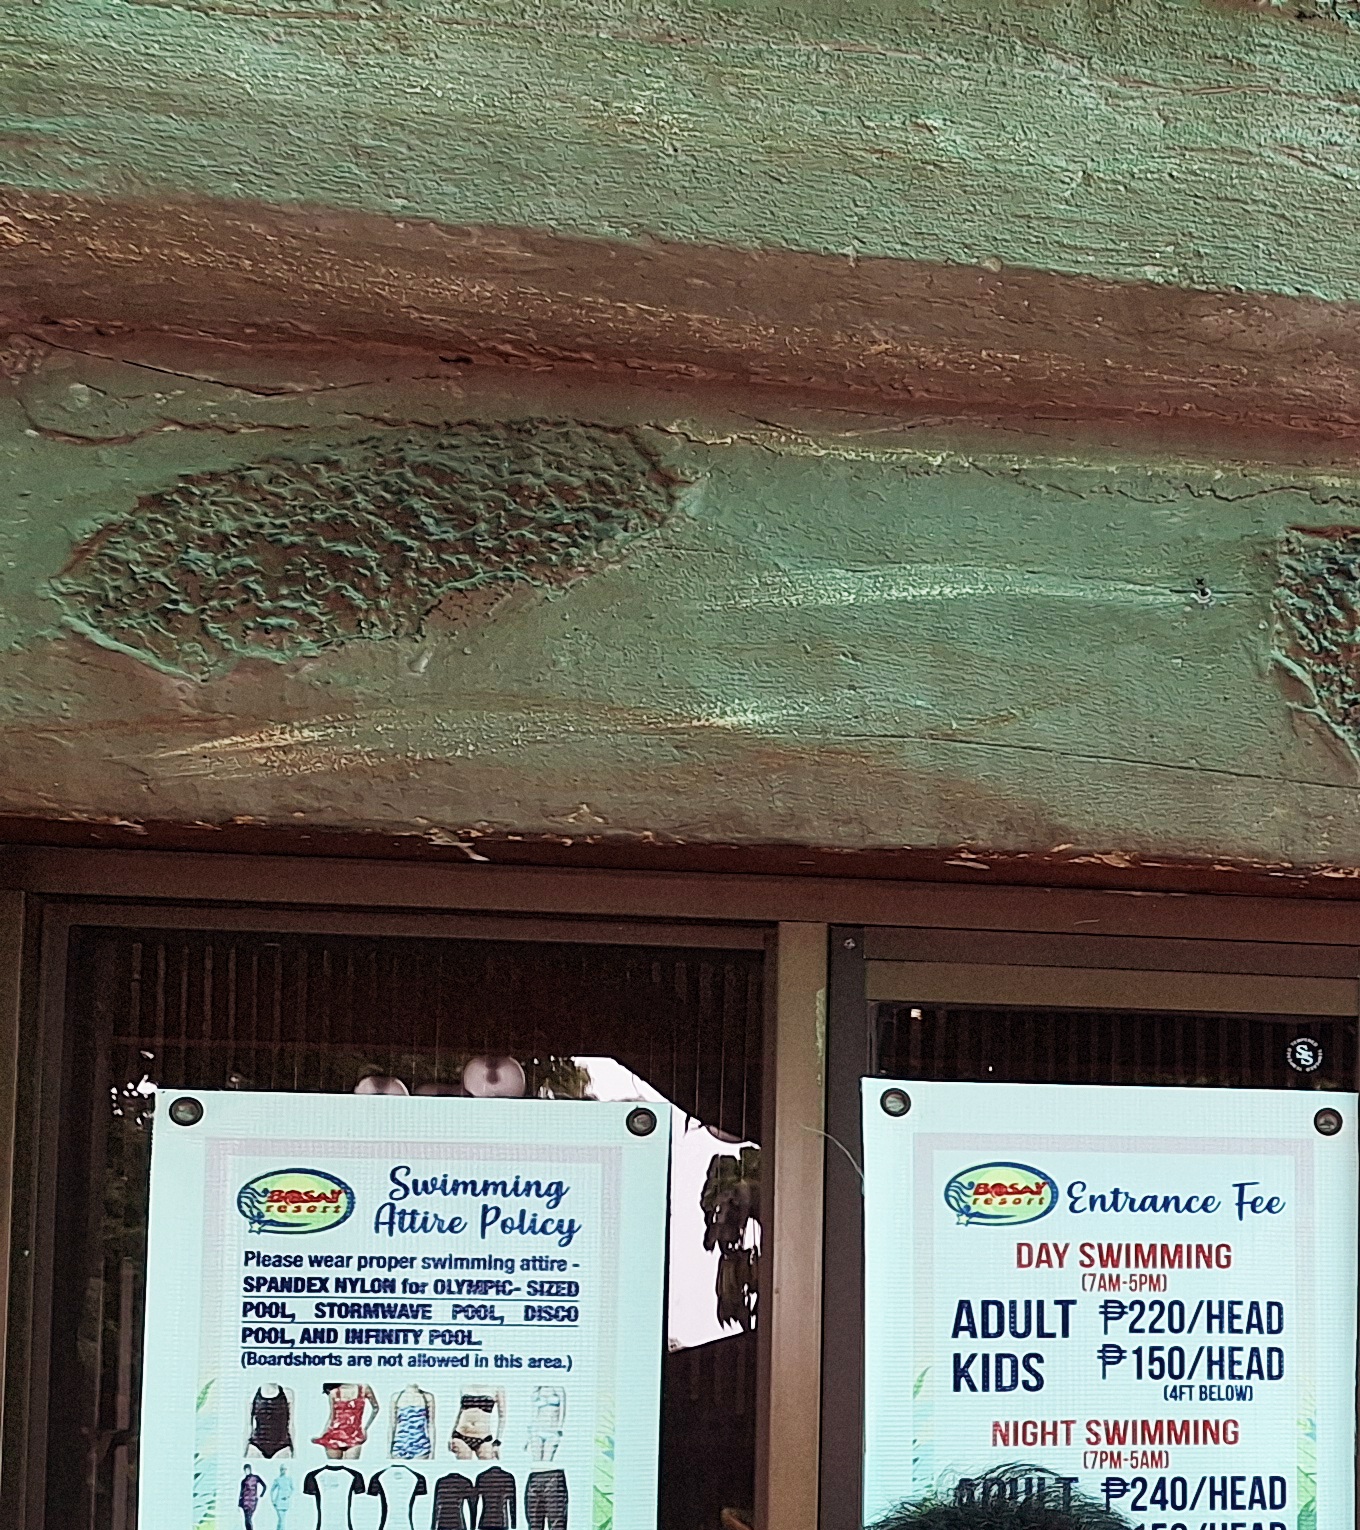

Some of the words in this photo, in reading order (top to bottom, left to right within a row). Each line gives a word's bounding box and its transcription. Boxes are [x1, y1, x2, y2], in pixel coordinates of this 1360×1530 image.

[388, 1166, 569, 1206] Swimming
[973, 1182, 1047, 1197] BOSAY
[265, 1204, 342, 1215] resort
[972, 1197, 1045, 1206] resort
[1067, 1181, 1221, 1213] Entrance
[1232, 1182, 1285, 1221] Fee
[373, 1203, 467, 1237] Attire
[479, 1205, 582, 1247] Policy
[244, 1251, 303, 1267] Please
[308, 1255, 353, 1268] wear
[357, 1256, 417, 1272] proper
[422, 1254, 515, 1274] swimming
[520, 1256, 567, 1272] attire
[1017, 1243, 1069, 1268] DAY
[1079, 1242, 1231, 1269] SWIMMING
[243, 1278, 328, 1294] SPANDEX
[334, 1279, 396, 1294] NYLON
[400, 1280, 426, 1294] for
[526, 1281, 580, 1298] SIZED
[1082, 1273, 1167, 1292] (7AM-5PM)
[242, 1302, 295, 1321] POOL,
[315, 1303, 432, 1320] STORMWAVE
[452, 1304, 504, 1324] POOL,
[524, 1305, 578, 1322] DISCO
[951, 1300, 1077, 1338] ADULT
[242, 1328, 295, 1347] POOL,
[300, 1328, 338, 1348] AND
[345, 1329, 423, 1348] INFINITY
[241, 1351, 342, 1369] (Boardshorts
[347, 1356, 372, 1367] are
[378, 1353, 403, 1367] not
[408, 1353, 469, 1367] allowed
[475, 1354, 488, 1368] in
[494, 1354, 522, 1368] this
[528, 1355, 572, 1372] area.)
[953, 1353, 1044, 1392] KIDS
[1164, 1385, 1195, 1401] (4FT
[1199, 1385, 1253, 1401] BELOW)
[992, 1420, 1076, 1446] NIGHT
[1086, 1419, 1238, 1445] SWIMMING
[1084, 1450, 1169, 1469] (7PM-5AM)
